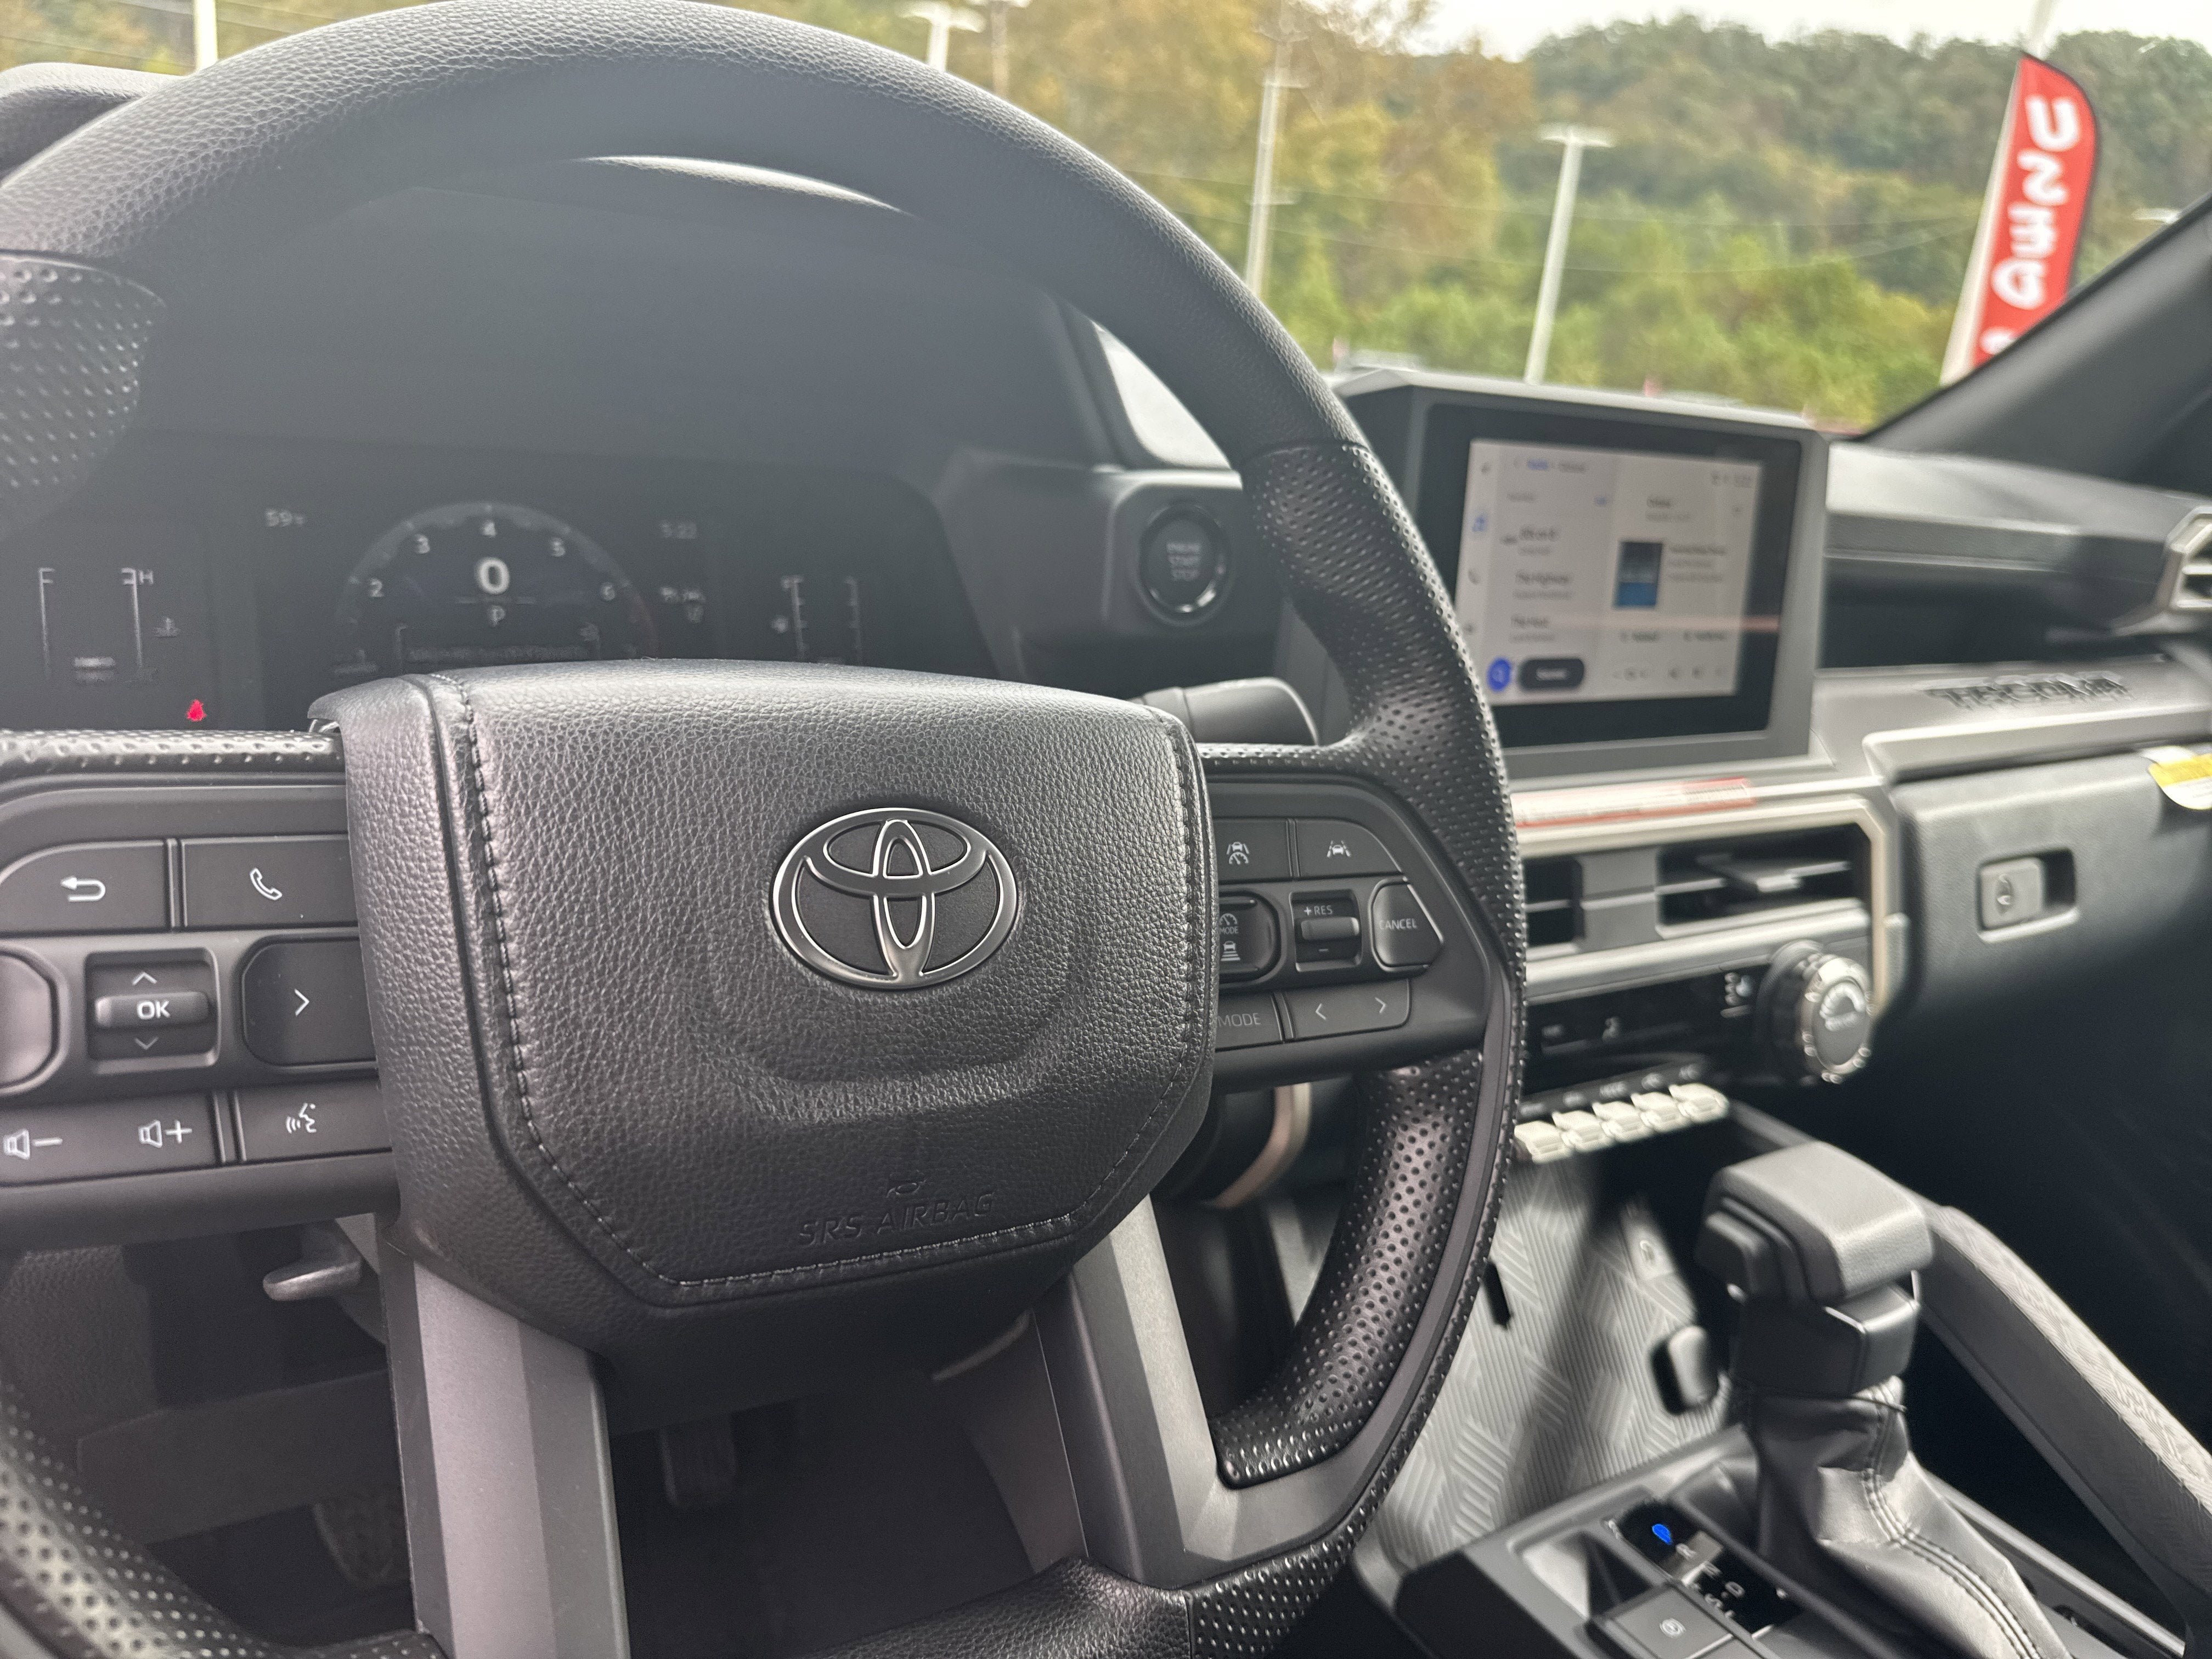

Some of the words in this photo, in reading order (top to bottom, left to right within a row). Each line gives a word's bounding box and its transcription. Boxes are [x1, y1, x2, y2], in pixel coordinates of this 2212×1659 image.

[415, 534, 430, 554] 3
[138, 569, 154, 585] H
[476, 557, 510, 595] 0
[369, 577, 383, 597] 2
[489, 605, 505, 628] P
[1379, 918, 1418, 930] CANCEL
[137, 1000, 170, 1020] OK
[1217, 1012, 1261, 1027] MODE
[799, 1216, 862, 1249] SRS
[877, 1193, 994, 1234] AIRBAG
